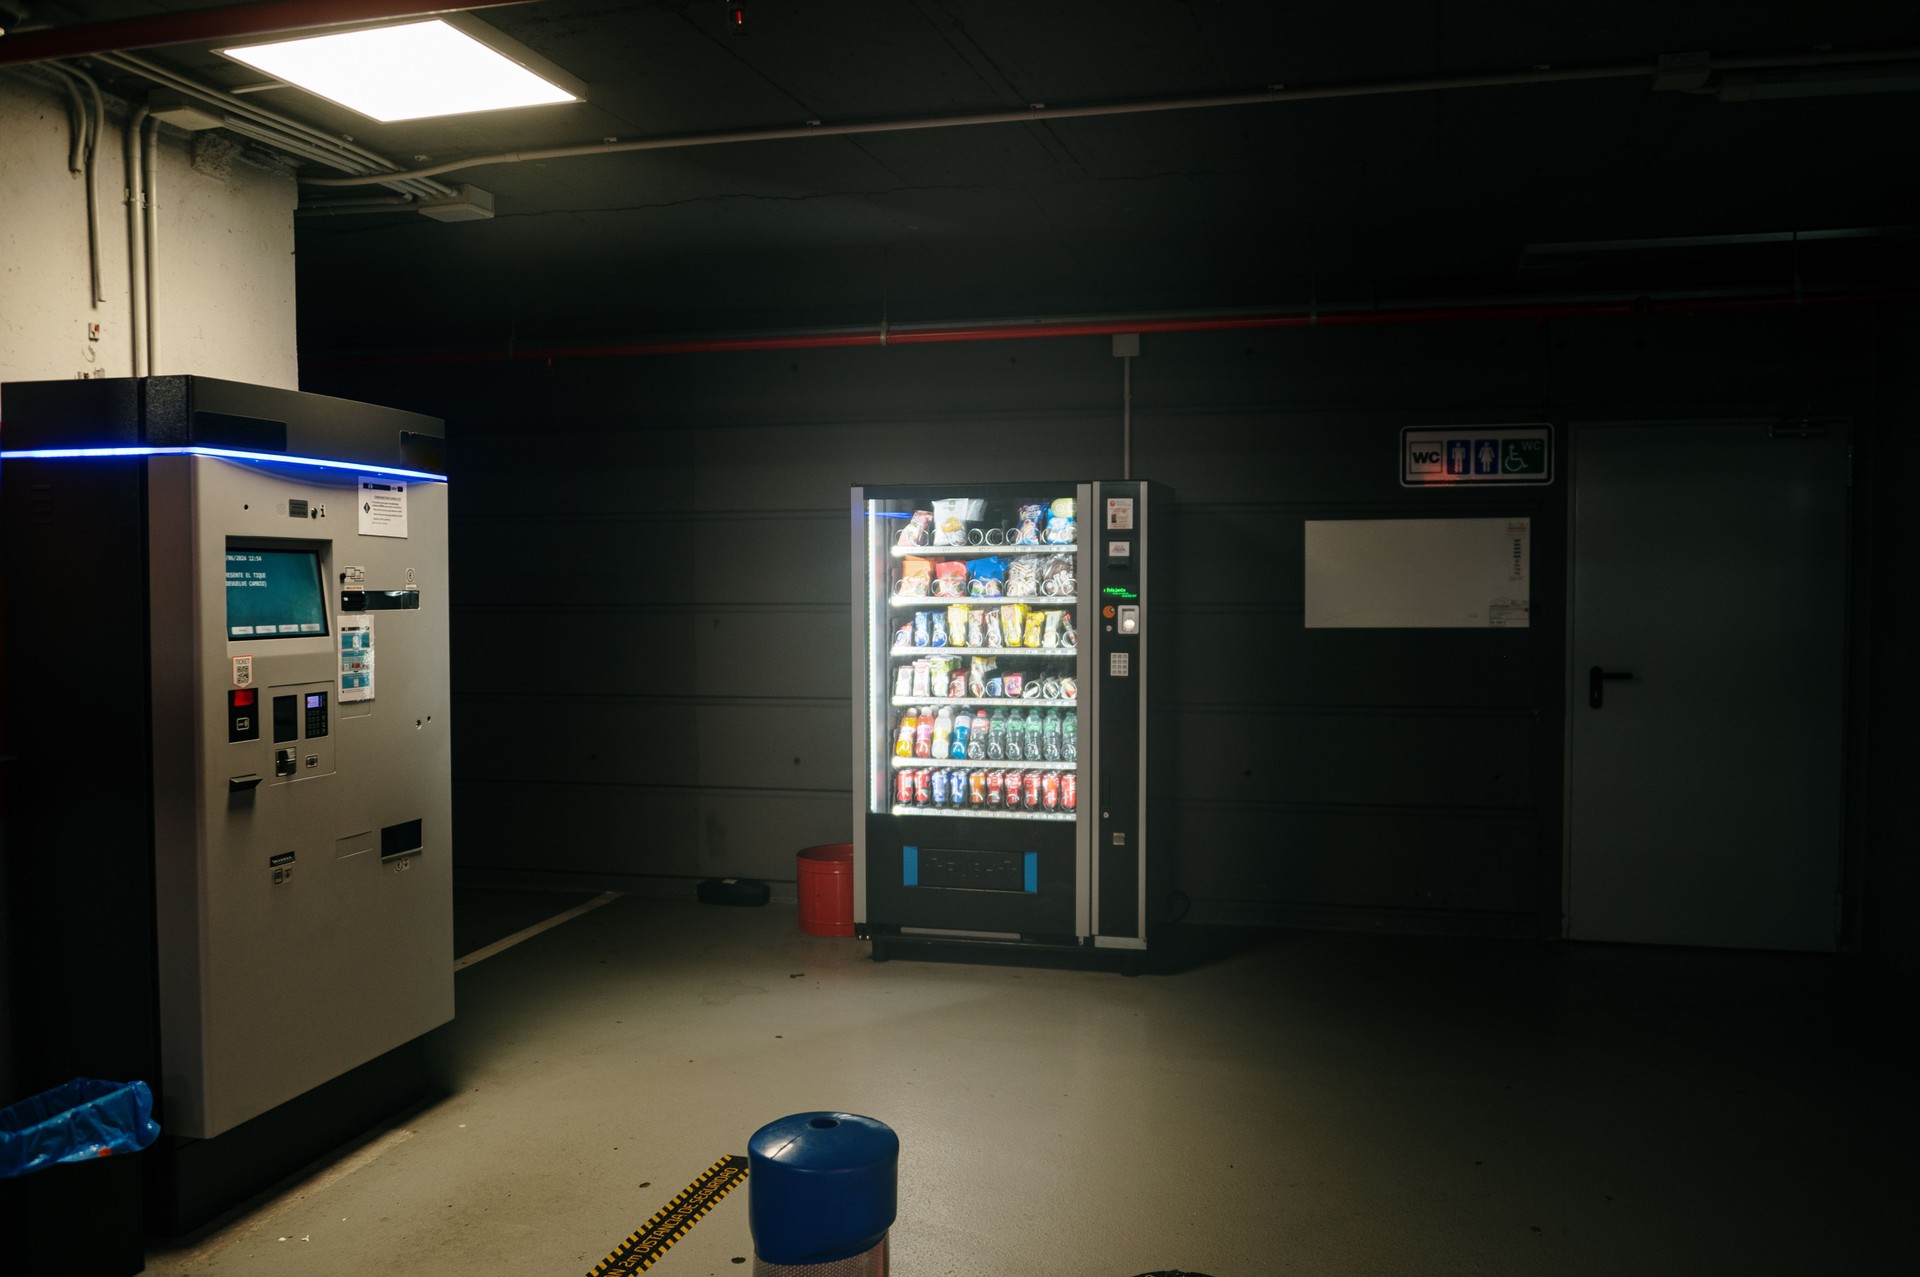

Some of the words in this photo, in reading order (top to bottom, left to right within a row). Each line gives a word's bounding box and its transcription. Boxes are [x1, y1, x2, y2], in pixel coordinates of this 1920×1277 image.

[1520, 440, 1542, 450] WC
[1412, 450, 1441, 464] WC
[618, 1254, 643, 1267] 2m
[634, 1214, 687, 1253] DISTANCIA
[677, 1203, 699, 1214] DE
[689, 1167, 738, 1204] SEGURIDAD
